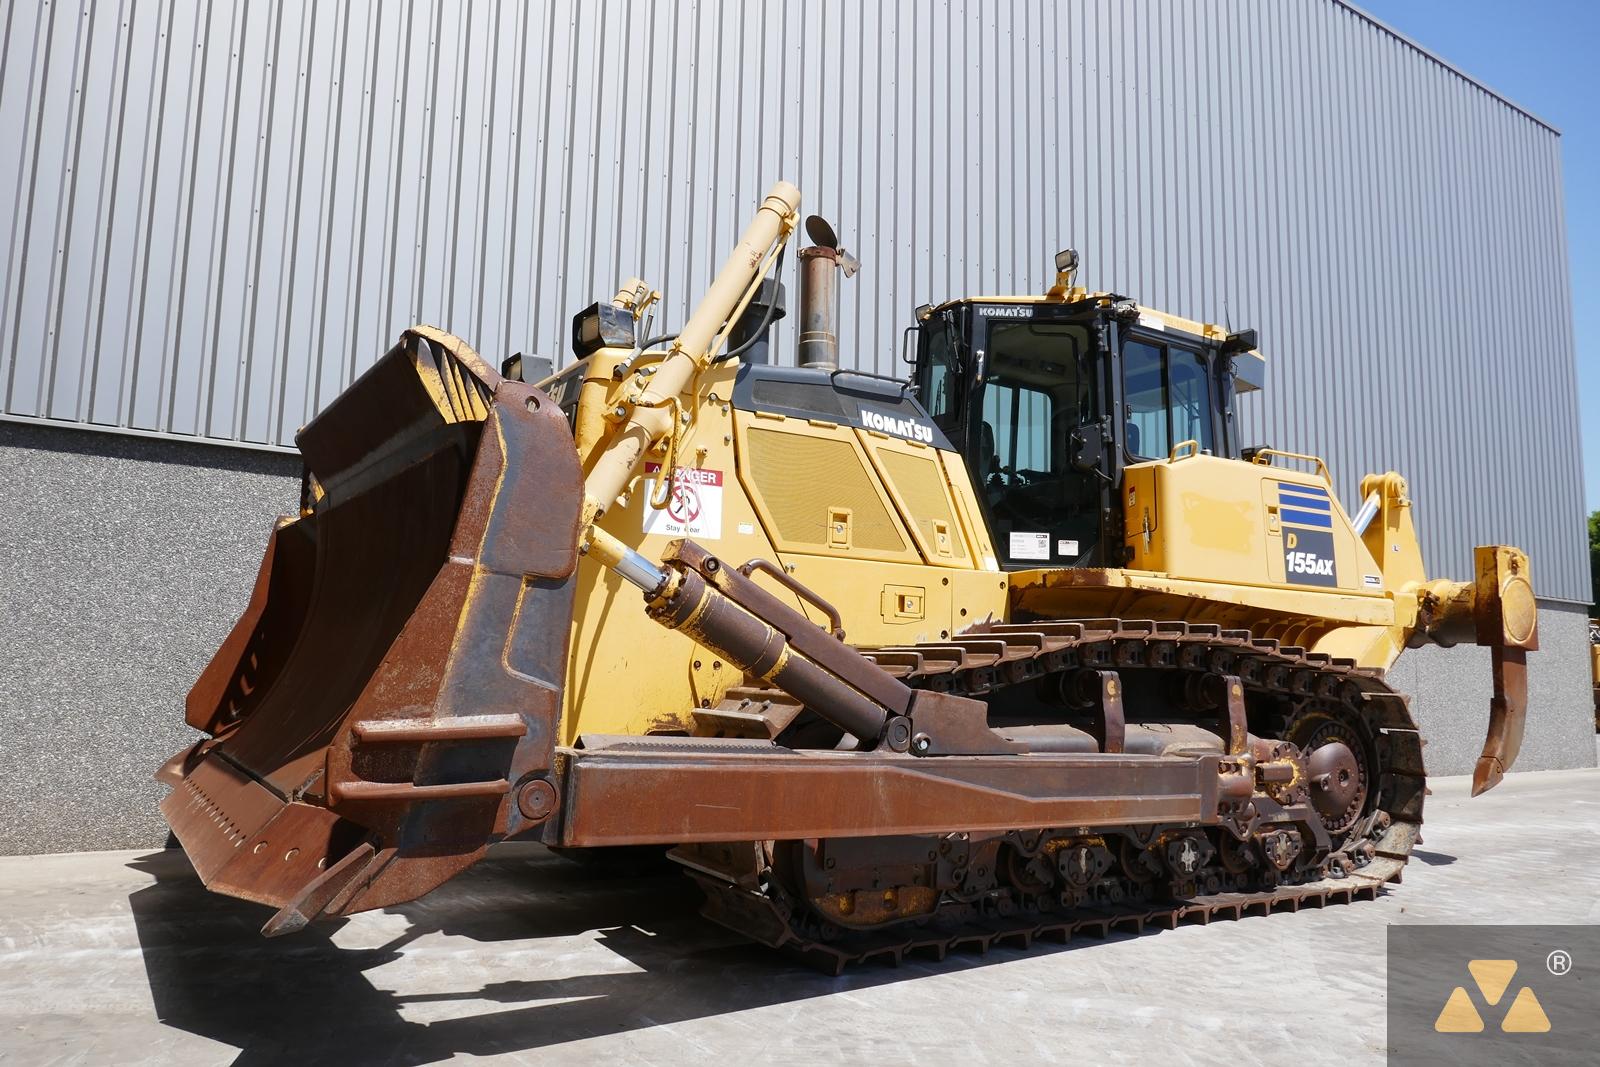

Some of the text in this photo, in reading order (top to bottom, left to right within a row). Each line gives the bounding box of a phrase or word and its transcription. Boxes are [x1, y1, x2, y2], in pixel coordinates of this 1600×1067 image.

[979, 307, 1033, 317] KOMATSU
[861, 410, 933, 443] KOMATSU
[666, 524, 681, 533] Stay
[1287, 533, 1298, 549] D
[1286, 551, 1334, 576] 155AX
